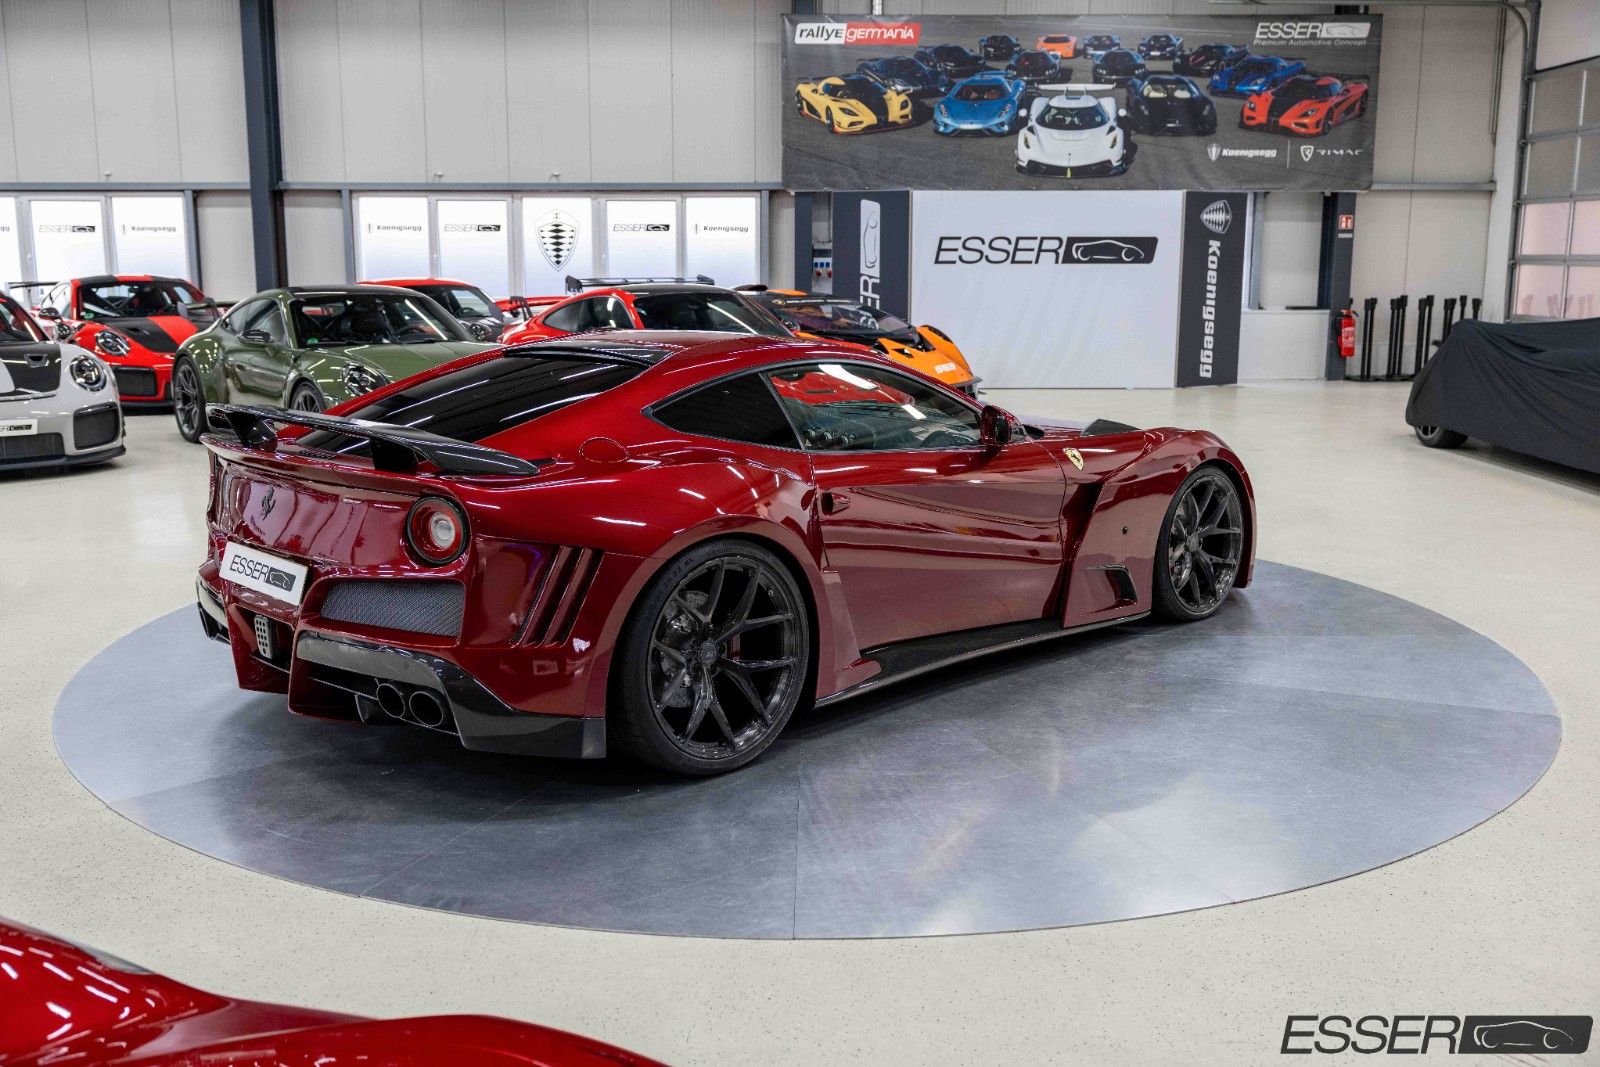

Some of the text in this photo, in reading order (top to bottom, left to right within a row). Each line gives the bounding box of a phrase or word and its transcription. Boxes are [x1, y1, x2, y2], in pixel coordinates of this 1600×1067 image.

[1255, 22, 1322, 38] ESSER
[1334, 39, 1367, 47] Concept
[1221, 148, 1277, 158] Koenigsegg
[38, 224, 72, 233] ESSER
[376, 224, 422, 232] Koenigsegg
[443, 223, 478, 232] ESSER
[612, 223, 648, 232] ESSER
[703, 225, 749, 233] Koenigsegg
[933, 236, 1064, 264] ESSER
[1199, 239, 1221, 378] Koenigsegg
[229, 554, 270, 582] ESSER
